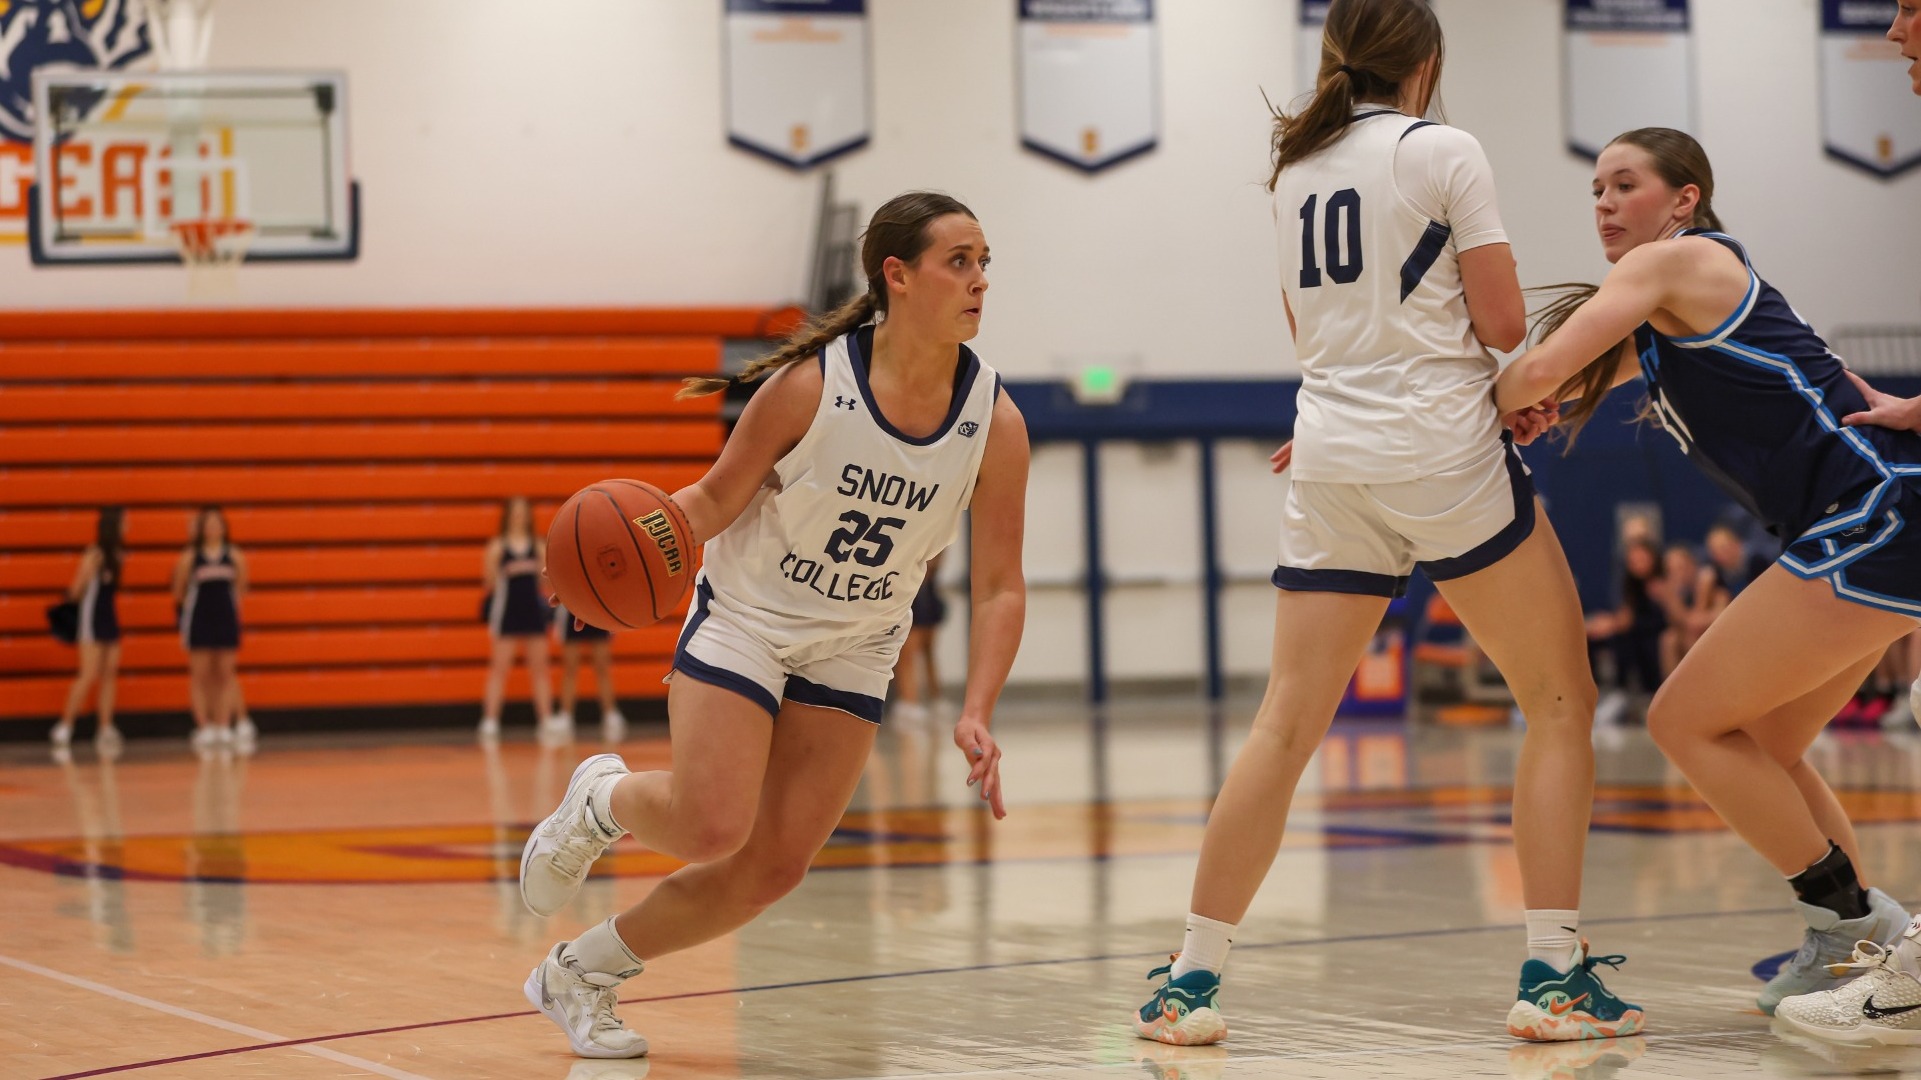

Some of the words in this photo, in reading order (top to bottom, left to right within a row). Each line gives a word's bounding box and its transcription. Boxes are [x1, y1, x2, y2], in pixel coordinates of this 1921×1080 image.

[1299, 187, 1364, 288] 10
[837, 463, 939, 512] SNOW
[637, 511, 682, 574] NJCAA
[824, 509, 907, 568] 25
[780, 550, 900, 602] COLLEGE
